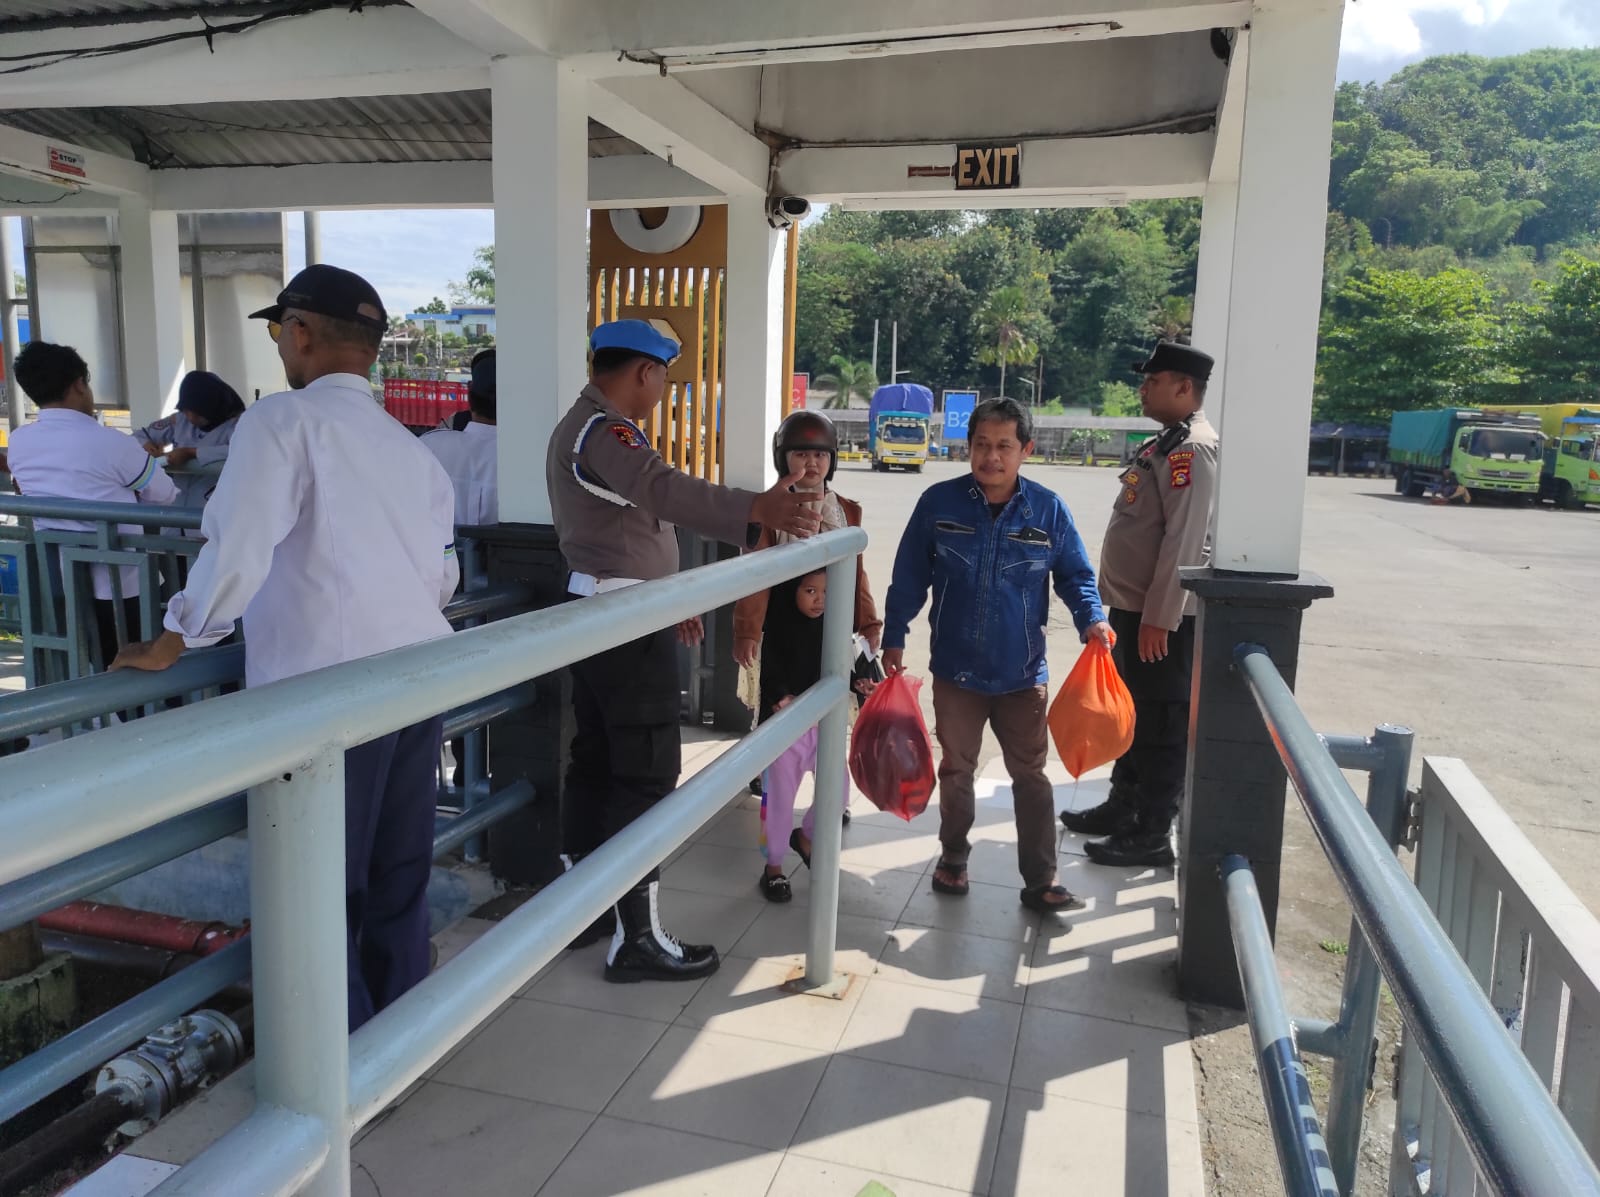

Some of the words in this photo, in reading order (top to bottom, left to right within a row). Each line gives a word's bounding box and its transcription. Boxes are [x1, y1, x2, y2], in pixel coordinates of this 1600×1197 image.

[59, 153, 78, 163] STOP
[958, 147, 1018, 186] EXIT
[947, 411, 970, 428] B2
